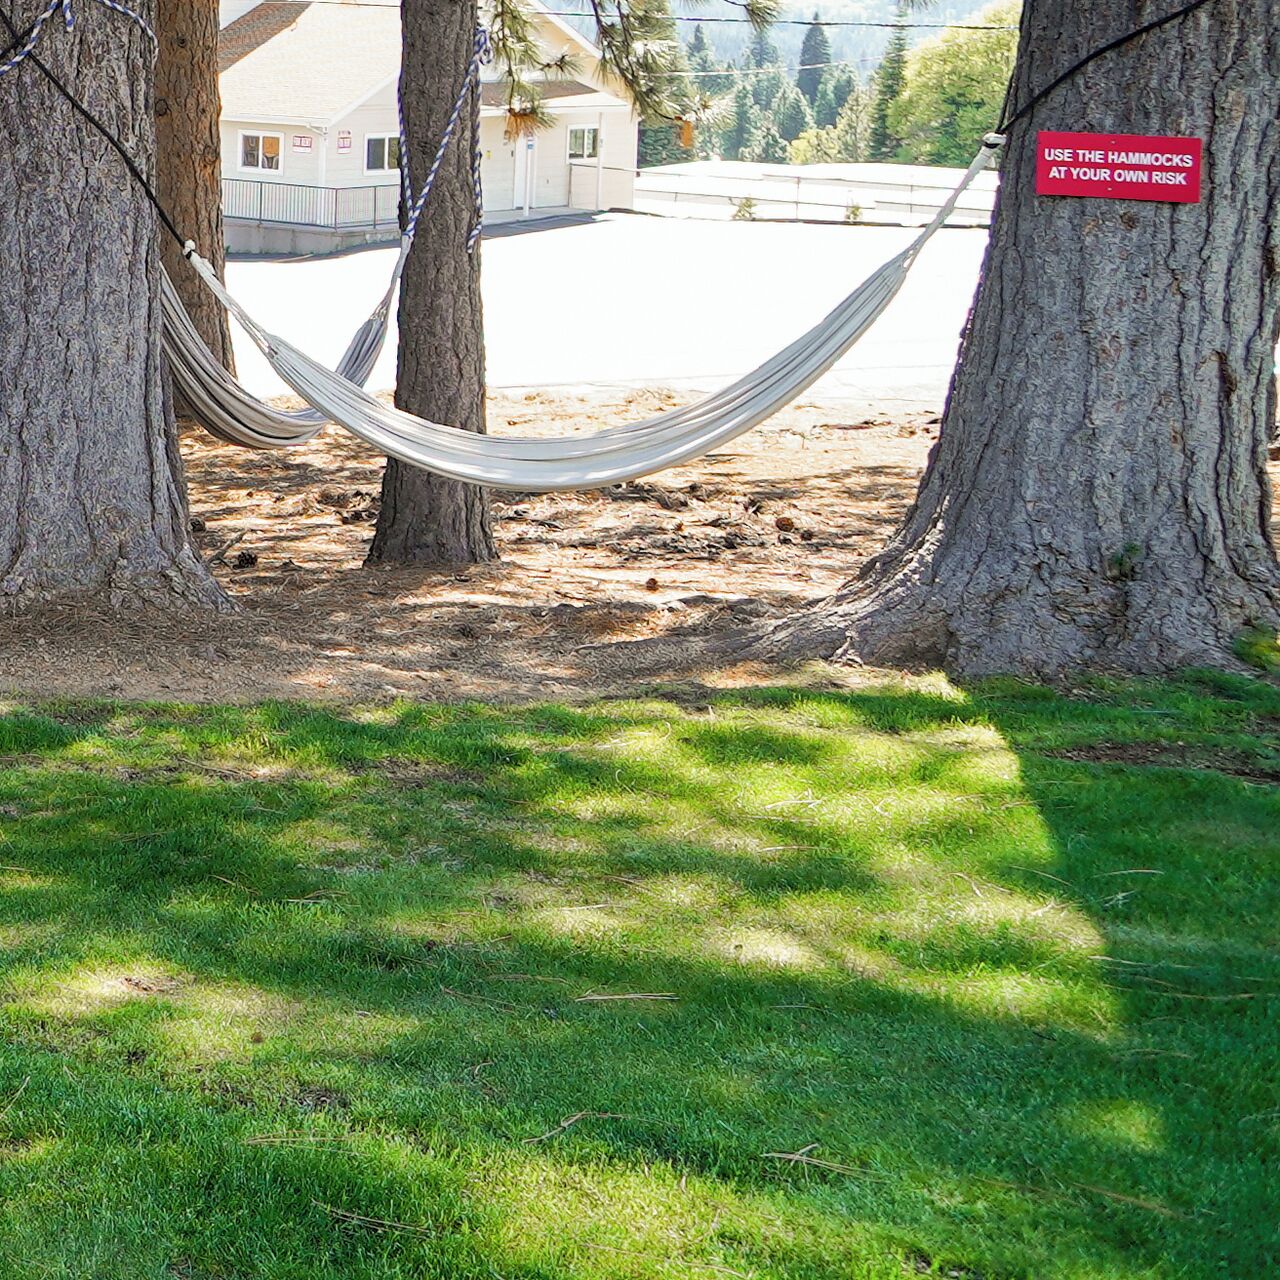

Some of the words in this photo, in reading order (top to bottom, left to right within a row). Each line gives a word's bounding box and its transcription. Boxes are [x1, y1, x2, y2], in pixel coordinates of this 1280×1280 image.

[1044, 148, 1073, 162] USE
[1076, 149, 1104, 163] THE
[1108, 151, 1193, 167] HAMMOCKS
[1049, 167, 1067, 179] AT
[1070, 167, 1110, 181] YOUR
[1114, 170, 1148, 183] OWN
[1152, 171, 1187, 185] RISK
